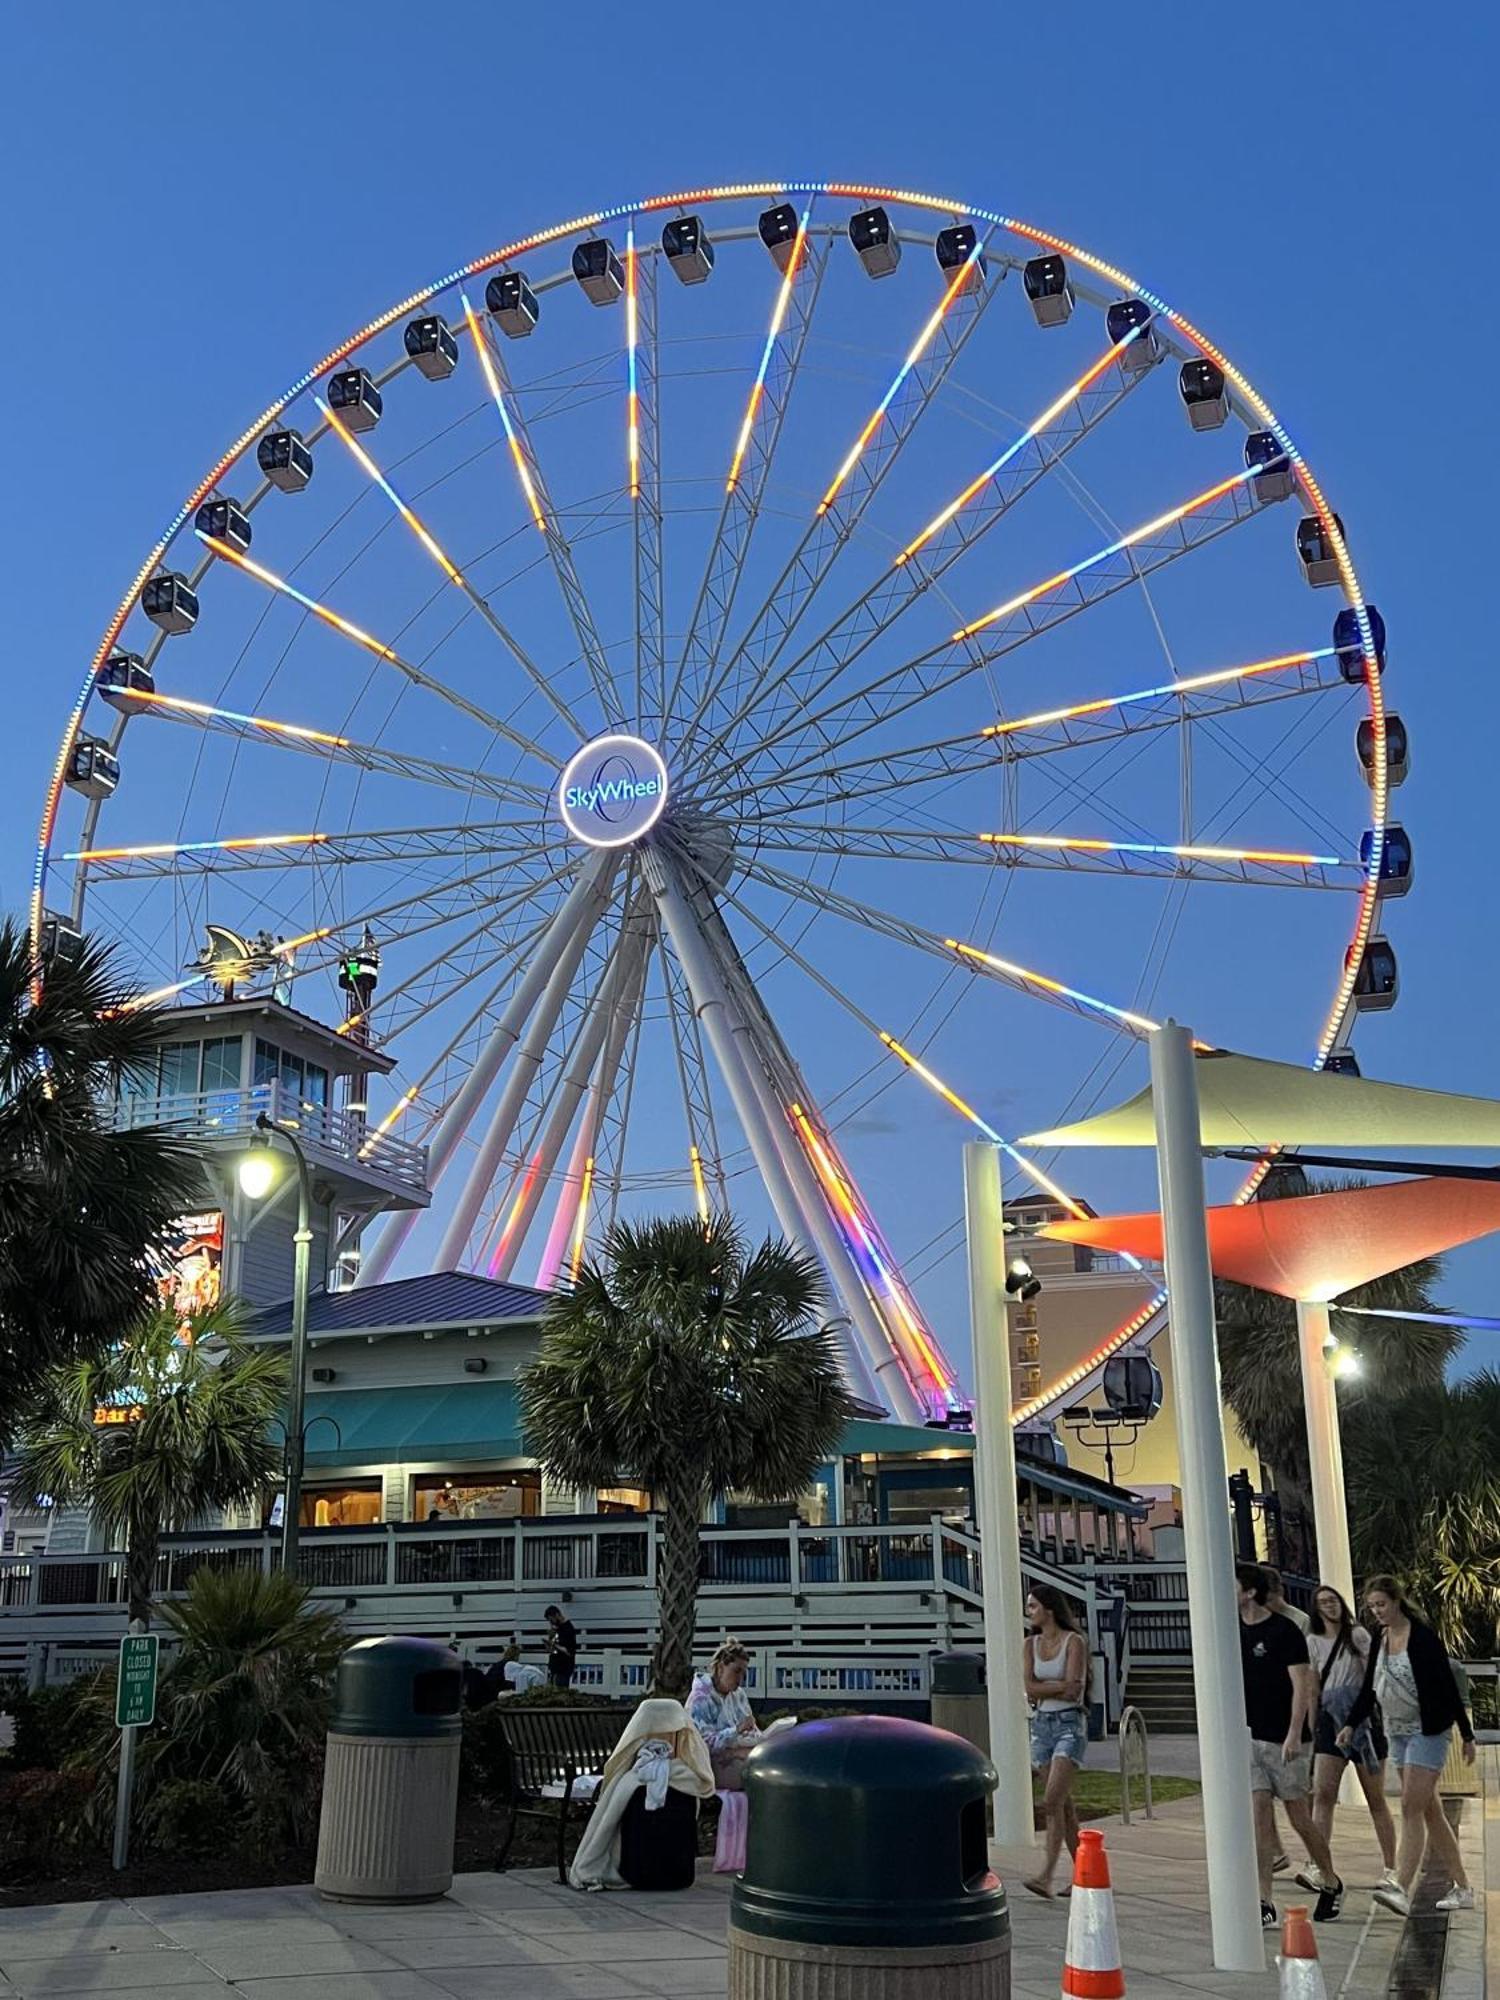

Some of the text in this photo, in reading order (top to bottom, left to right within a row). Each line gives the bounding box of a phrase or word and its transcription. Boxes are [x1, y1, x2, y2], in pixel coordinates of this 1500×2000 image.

[566, 773, 662, 811] SkyWheel
[93, 1408, 127, 1424] Bar
[131, 1640, 149, 1652] PARK
[127, 1655, 152, 1669] CLOSED
[134, 1683, 141, 1694] TO
[126, 1709, 144, 1721] DAILY
